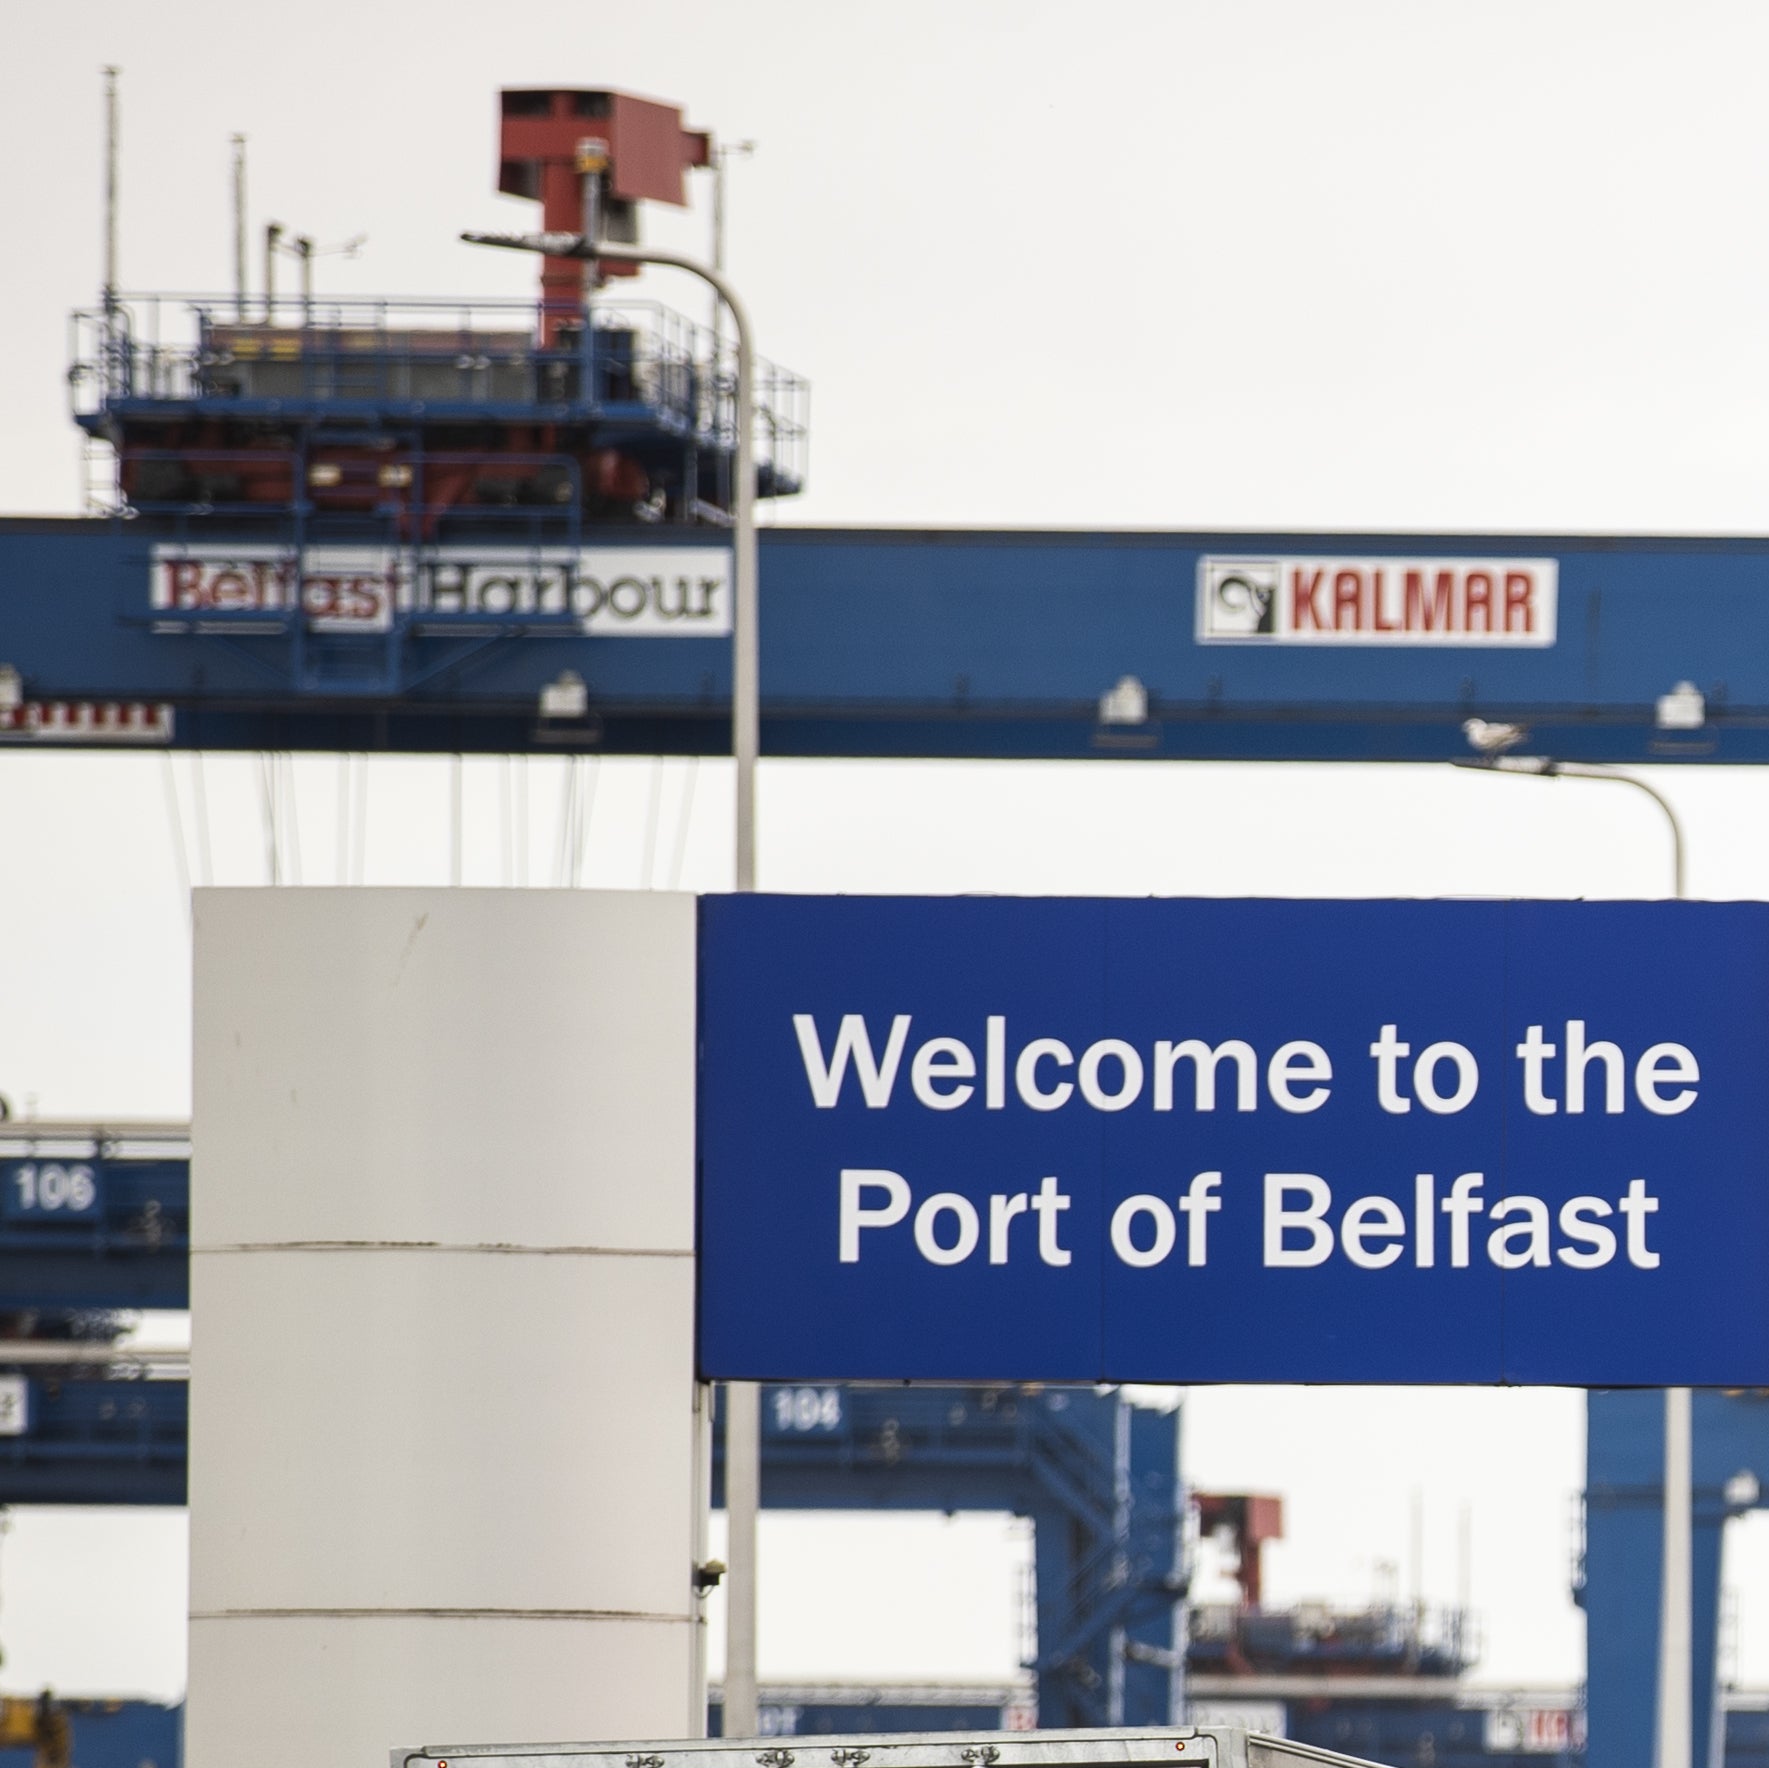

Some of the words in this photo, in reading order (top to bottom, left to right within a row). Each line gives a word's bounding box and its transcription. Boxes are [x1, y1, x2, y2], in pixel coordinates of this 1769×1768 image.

[424, 563, 727, 620] Harbour
[1290, 566, 1536, 636] KALMAR
[793, 1013, 1333, 1114] Welcome
[1370, 1023, 1479, 1115] to
[1516, 1019, 1700, 1115] the
[16, 1163, 96, 1211] 106
[838, 1168, 1072, 1267] Port
[1110, 1171, 1222, 1267] of
[1263, 1172, 1660, 1269] Belfast
